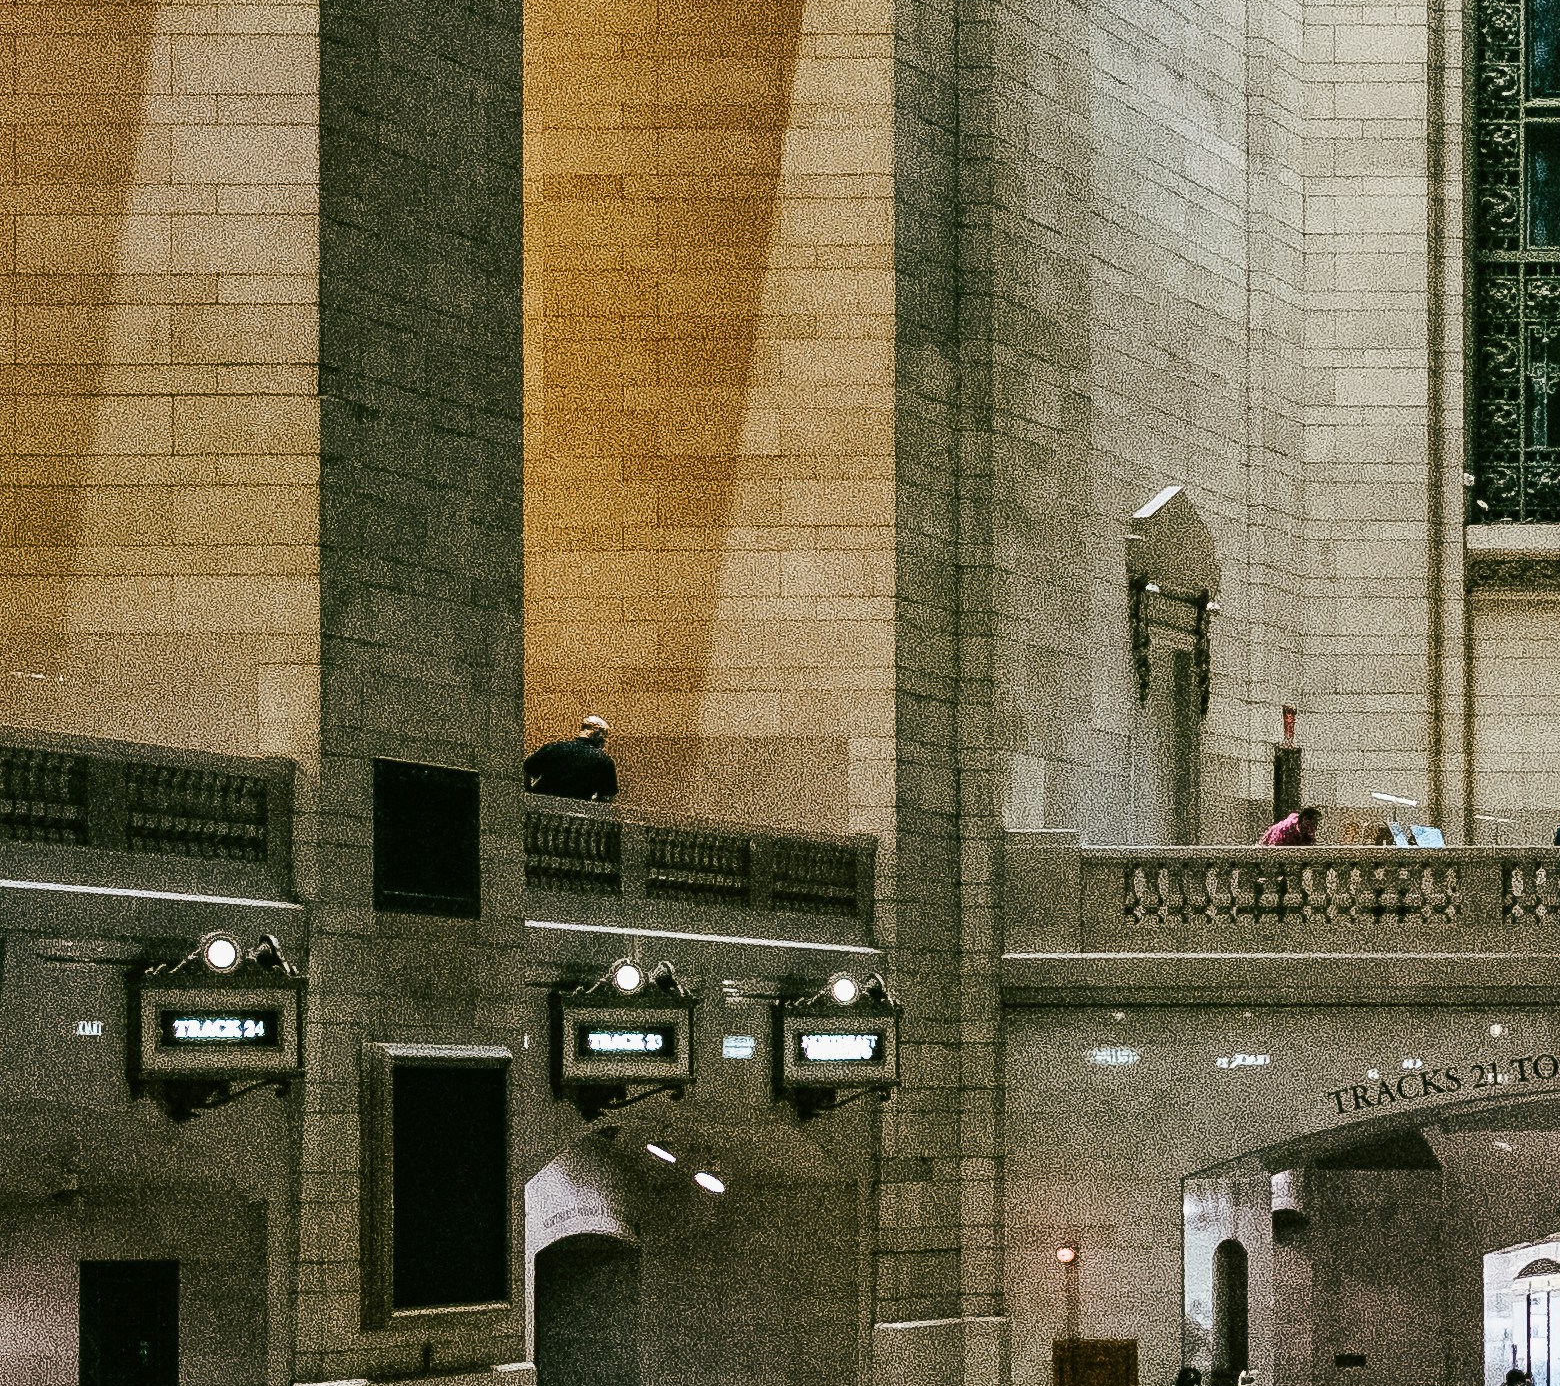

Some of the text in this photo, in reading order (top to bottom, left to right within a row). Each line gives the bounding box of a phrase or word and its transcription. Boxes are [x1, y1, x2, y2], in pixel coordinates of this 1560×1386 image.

[173, 1018, 265, 1038] TRACK 24
[1328, 1066, 1462, 1113] TRACKS
[1470, 1063, 1500, 1088] 21
[1511, 1054, 1559, 1083] TO
